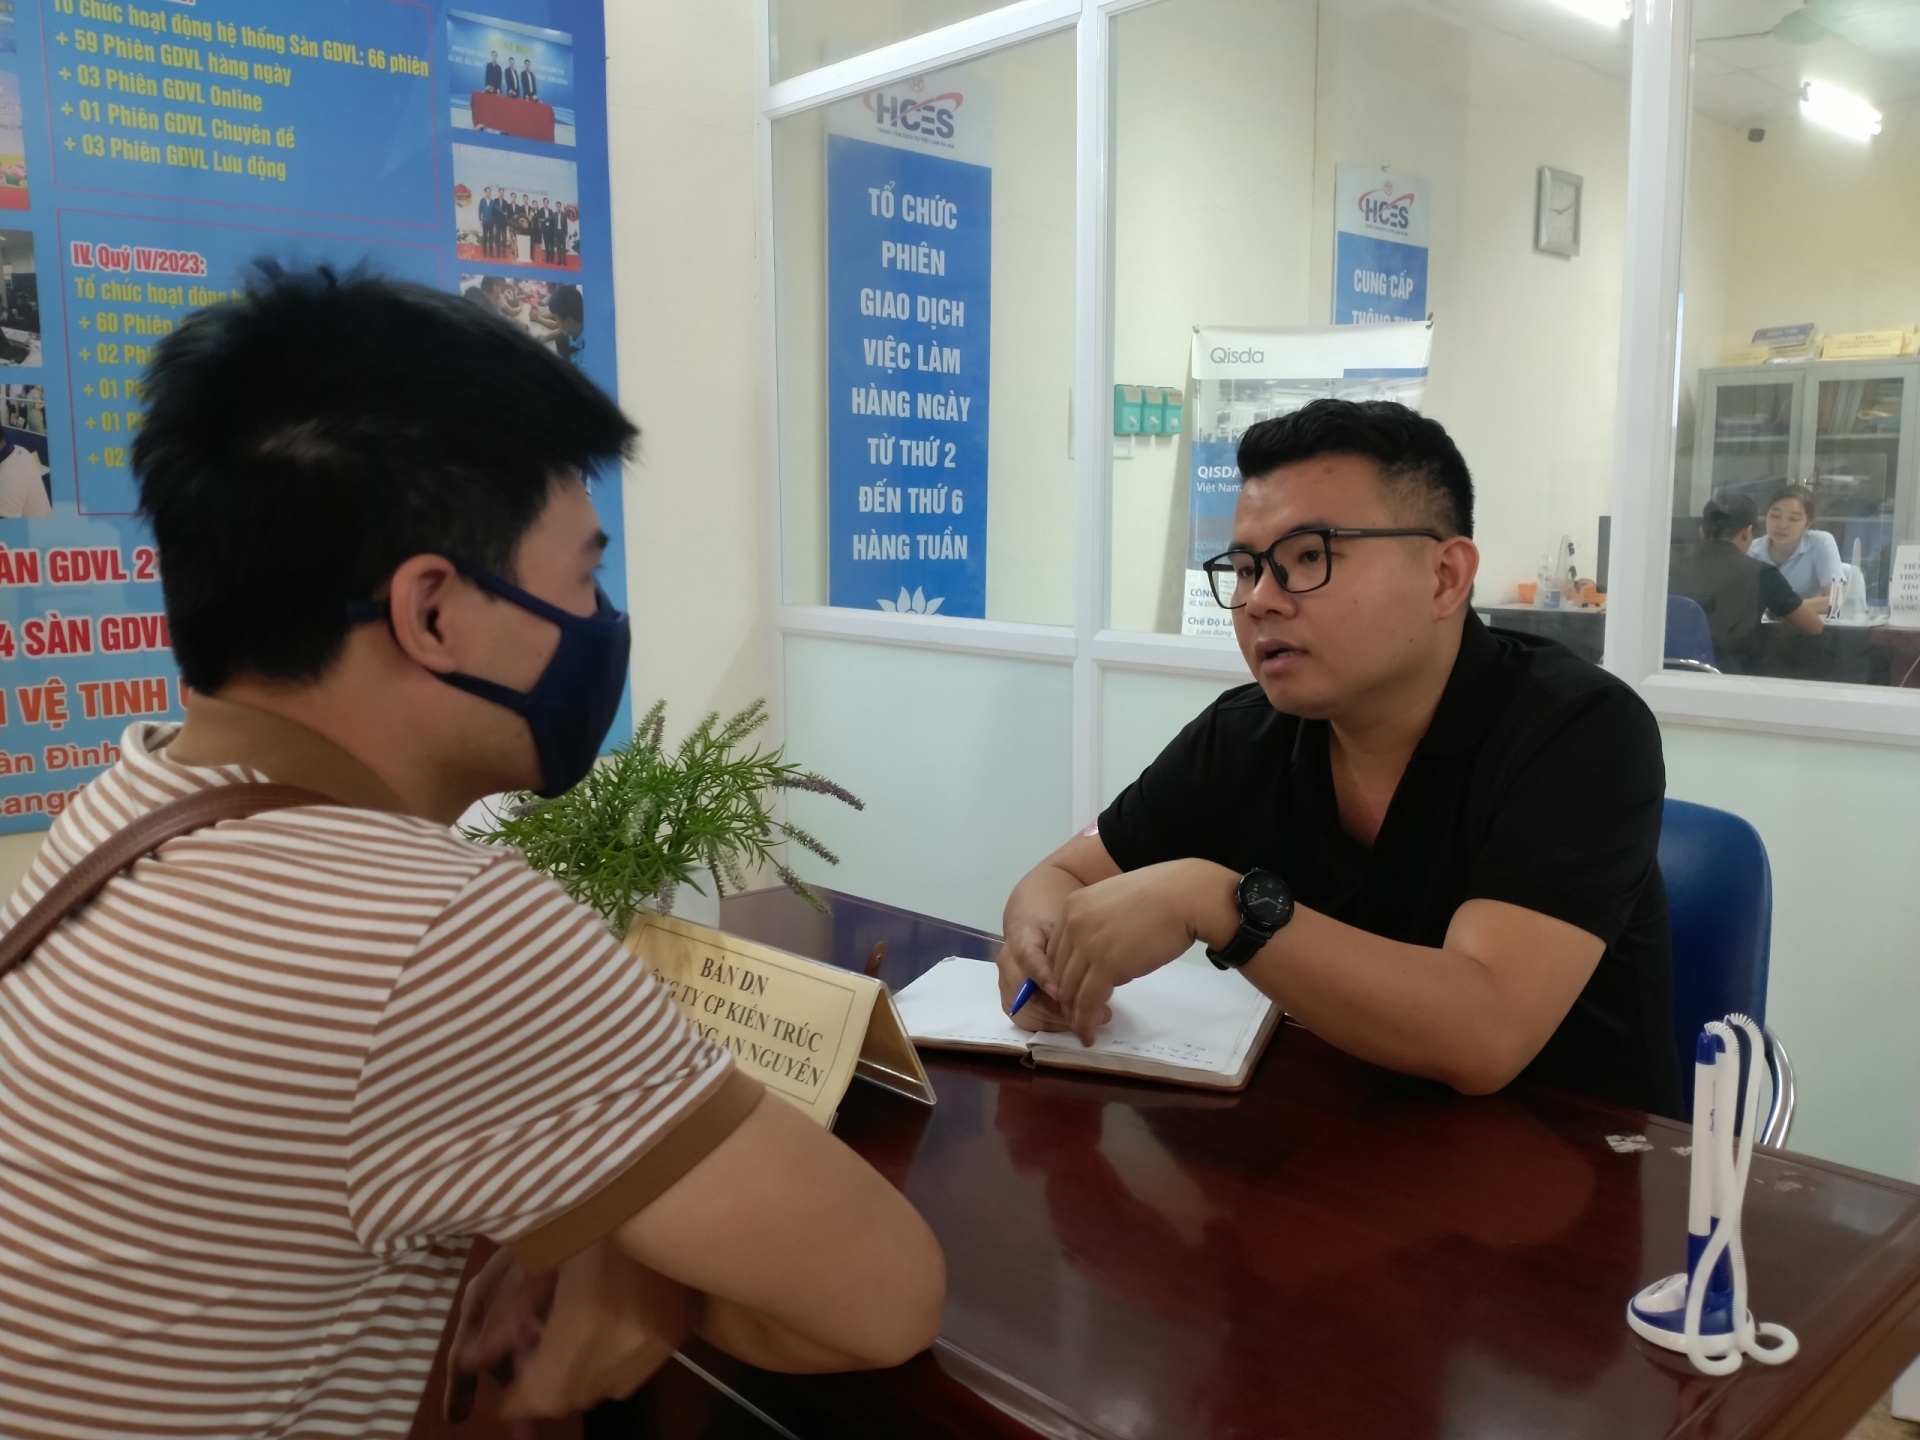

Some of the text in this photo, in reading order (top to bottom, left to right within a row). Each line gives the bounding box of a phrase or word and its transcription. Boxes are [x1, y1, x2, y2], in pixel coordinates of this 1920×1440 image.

[75, 29, 98, 53] 59
[103, 34, 155, 63] Phiên
[161, 44, 204, 71] GDVL
[208, 52, 248, 80] hàng
[253, 63, 291, 87] ngày
[128, 4, 167, 34] hoạt
[171, 14, 213, 42] động
[217, 21, 237, 48] hệ
[241, 26, 285, 55] thống
[290, 34, 319, 58] Sàn
[323, 40, 364, 66] GDVL:
[368, 49, 386, 69] 66
[390, 54, 429, 77] phiên
[77, 64, 100, 88] 03
[106, 68, 157, 97] Phiên
[163, 78, 206, 104] GDVL
[210, 85, 263, 112] Online
[79, 99, 100, 123] 01
[108, 103, 159, 130] Phiên
[164, 111, 207, 137] GDVL
[211, 118, 271, 145] Chuyên
[276, 125, 295, 149] đề
[876, 92, 955, 139] HCES
[82, 134, 105, 157] 03
[110, 137, 161, 164] Phiên
[166, 144, 209, 170] GDVL
[213, 151, 243, 173] Lưu
[247, 156, 287, 181] động
[868, 180, 957, 230] TỔ CHỨC
[1365, 198, 1409, 229] HCES
[98, 246, 131, 271] Quý
[135, 248, 205, 274] IV/2023:
[881, 241, 945, 276] PHIÊN
[75, 274, 96, 299] Tổ
[102, 280, 142, 302] chức
[148, 283, 184, 309] hoạt
[1354, 269, 1414, 300] CUNG CẤP
[96, 312, 118, 333] 60
[124, 313, 173, 336] Phiên
[861, 288, 964, 330] GIAO DỊCH
[97, 344, 119, 364] 02
[863, 335, 960, 374] VIỆC LÀM
[1210, 346, 1264, 365] Qisda
[100, 379, 118, 399] 01
[851, 383, 971, 422] HÀNG NGÀY
[102, 411, 120, 432] 01
[104, 447, 124, 468] 02
[867, 433, 956, 468] TỪ THỨ 2
[858, 479, 963, 515] ĐẾN THỨ 6
[1197, 482, 1215, 494] Việt
[853, 526, 968, 560] HÀNG TUẦN
[0, 544, 159, 585] ÀN GDVL 2
[24, 613, 92, 656] SÀN
[1188, 616, 1233, 628] Chế Độ Là
[18, 679, 68, 729] VỆ
[78, 678, 167, 718] TINH
[700, 956, 770, 997] BÀN DN
[681, 985, 704, 1006] TY
[704, 994, 725, 1014] CP
[725, 1001, 771, 1031] KIẾN
[772, 1017, 824, 1053] TRÚC
[721, 1035, 745, 1056] AN
[745, 1043, 824, 1088] NGUYÊN
